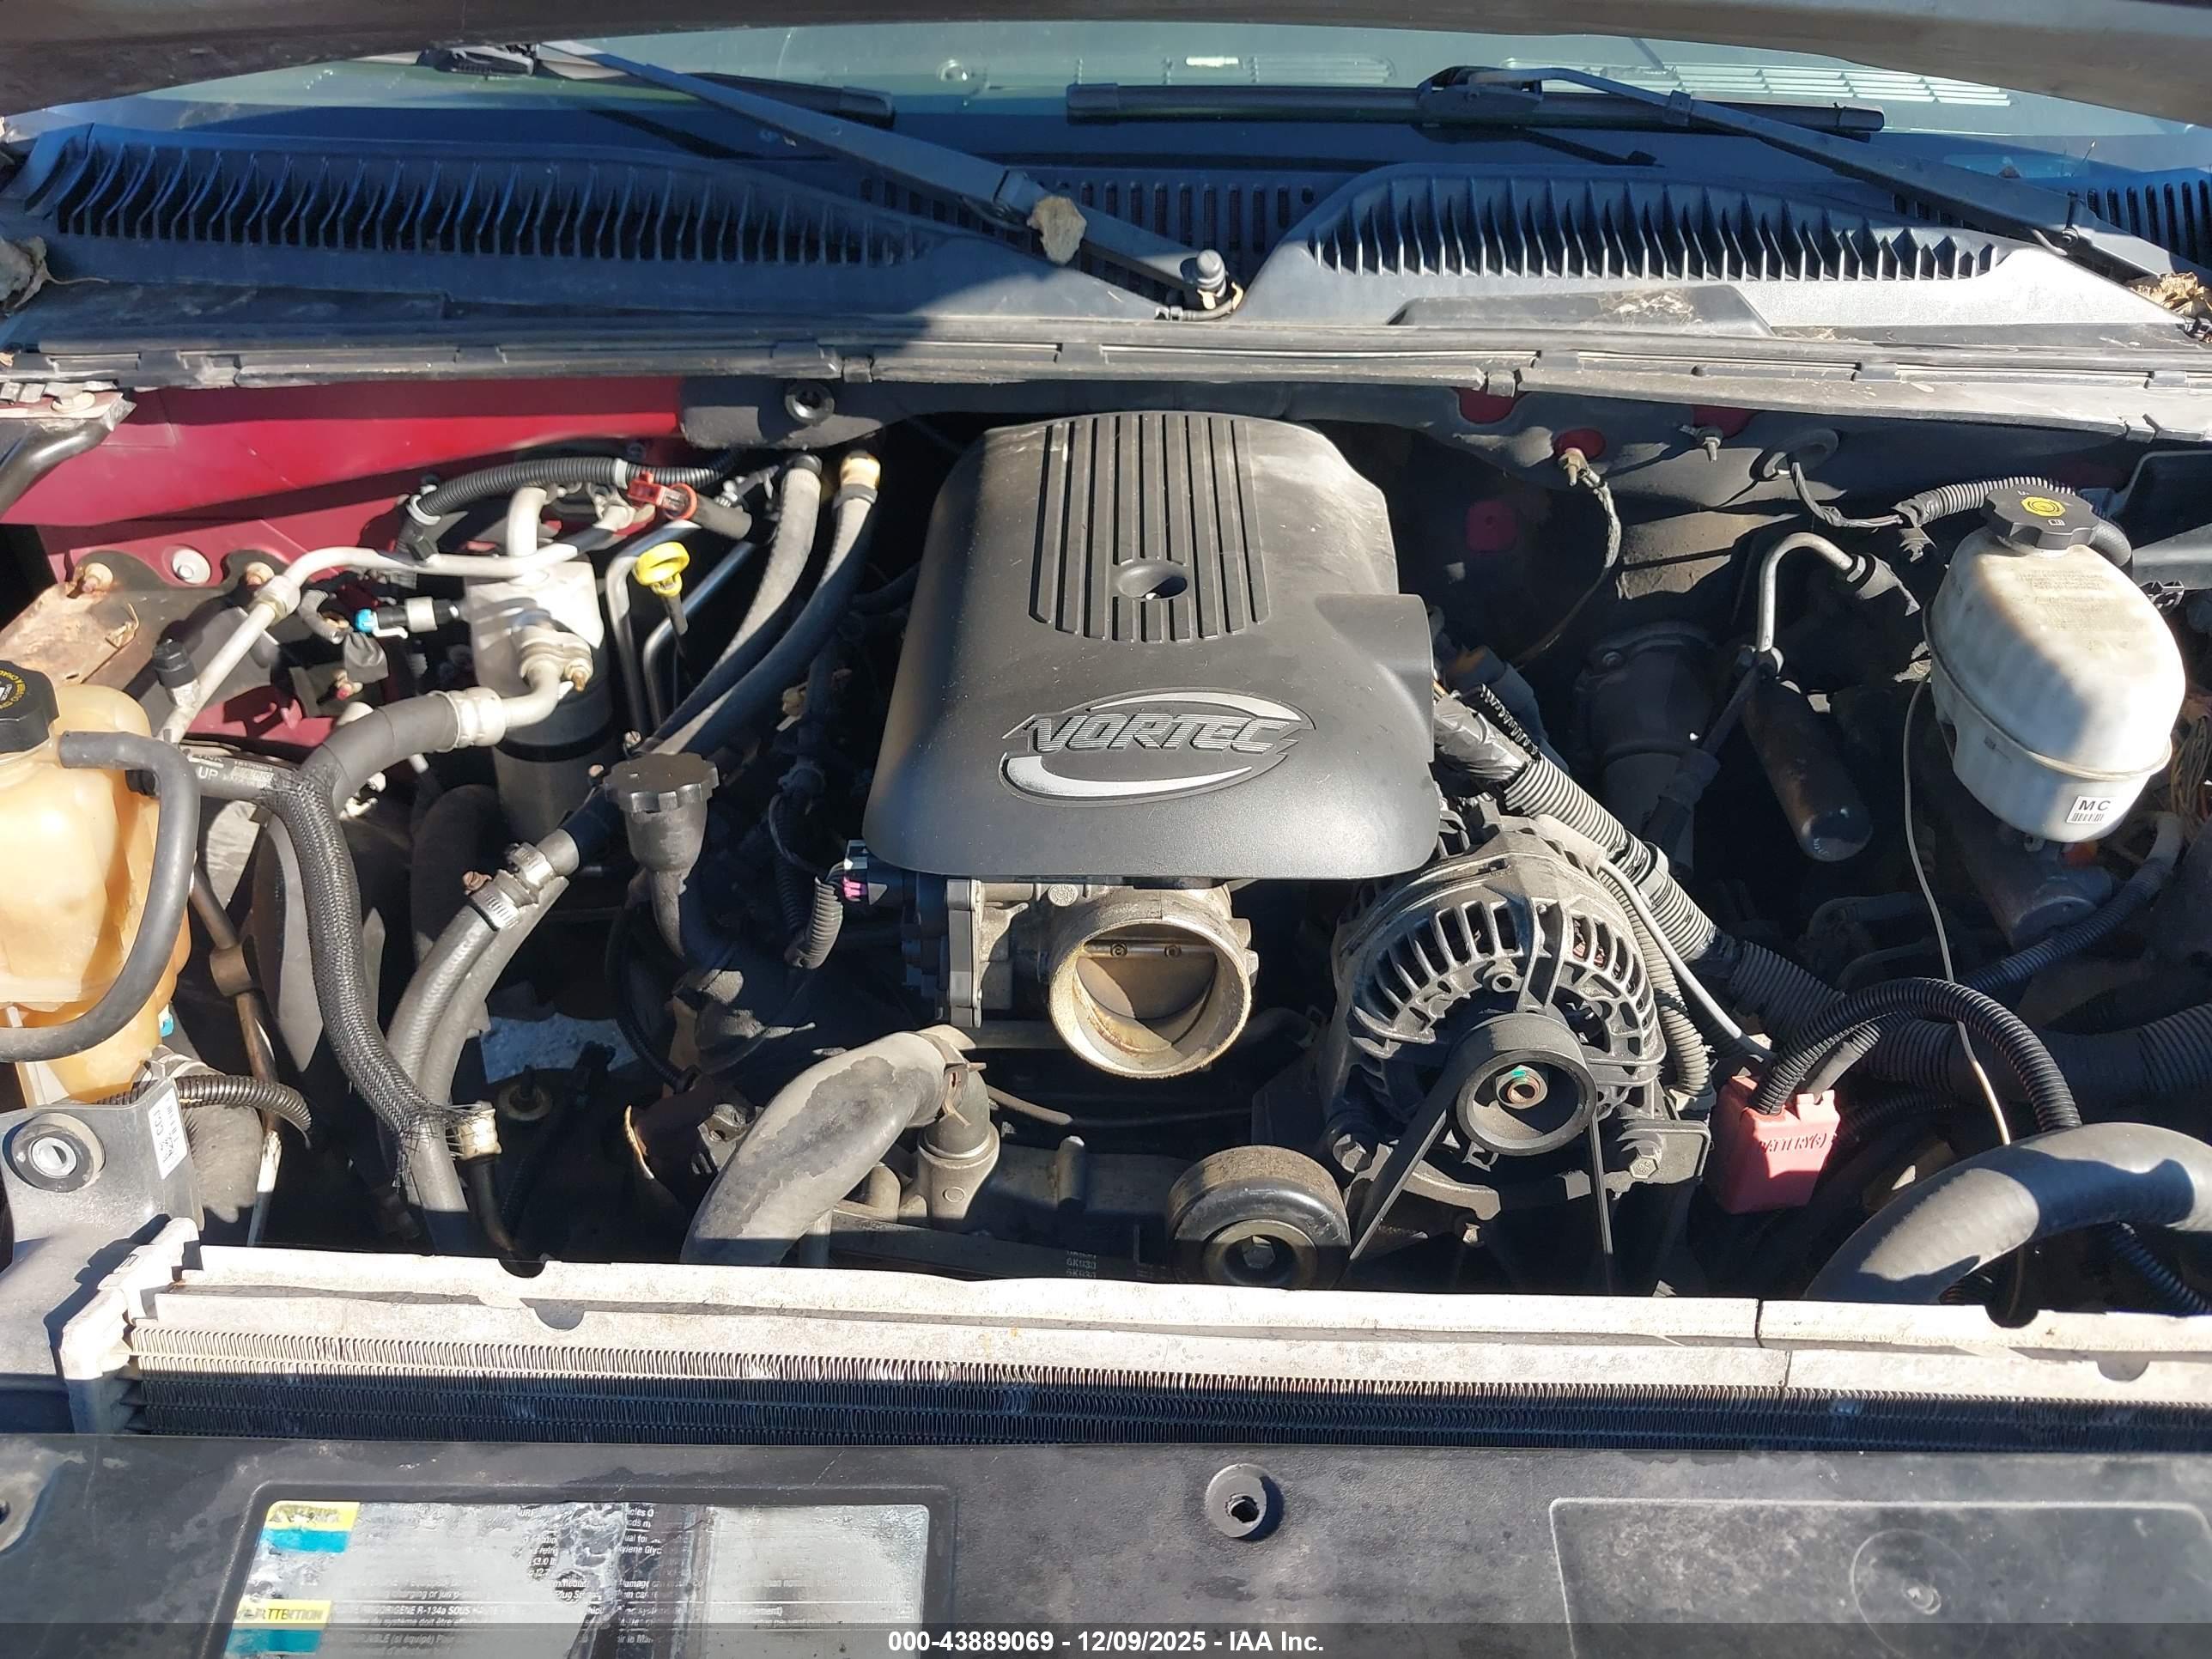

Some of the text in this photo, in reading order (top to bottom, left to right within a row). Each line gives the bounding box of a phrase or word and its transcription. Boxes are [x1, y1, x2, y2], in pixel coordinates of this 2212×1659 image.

[1023, 712, 1290, 754] VORTEC
[198, 765, 219, 781] UP
[2078, 799, 2111, 811] MC
